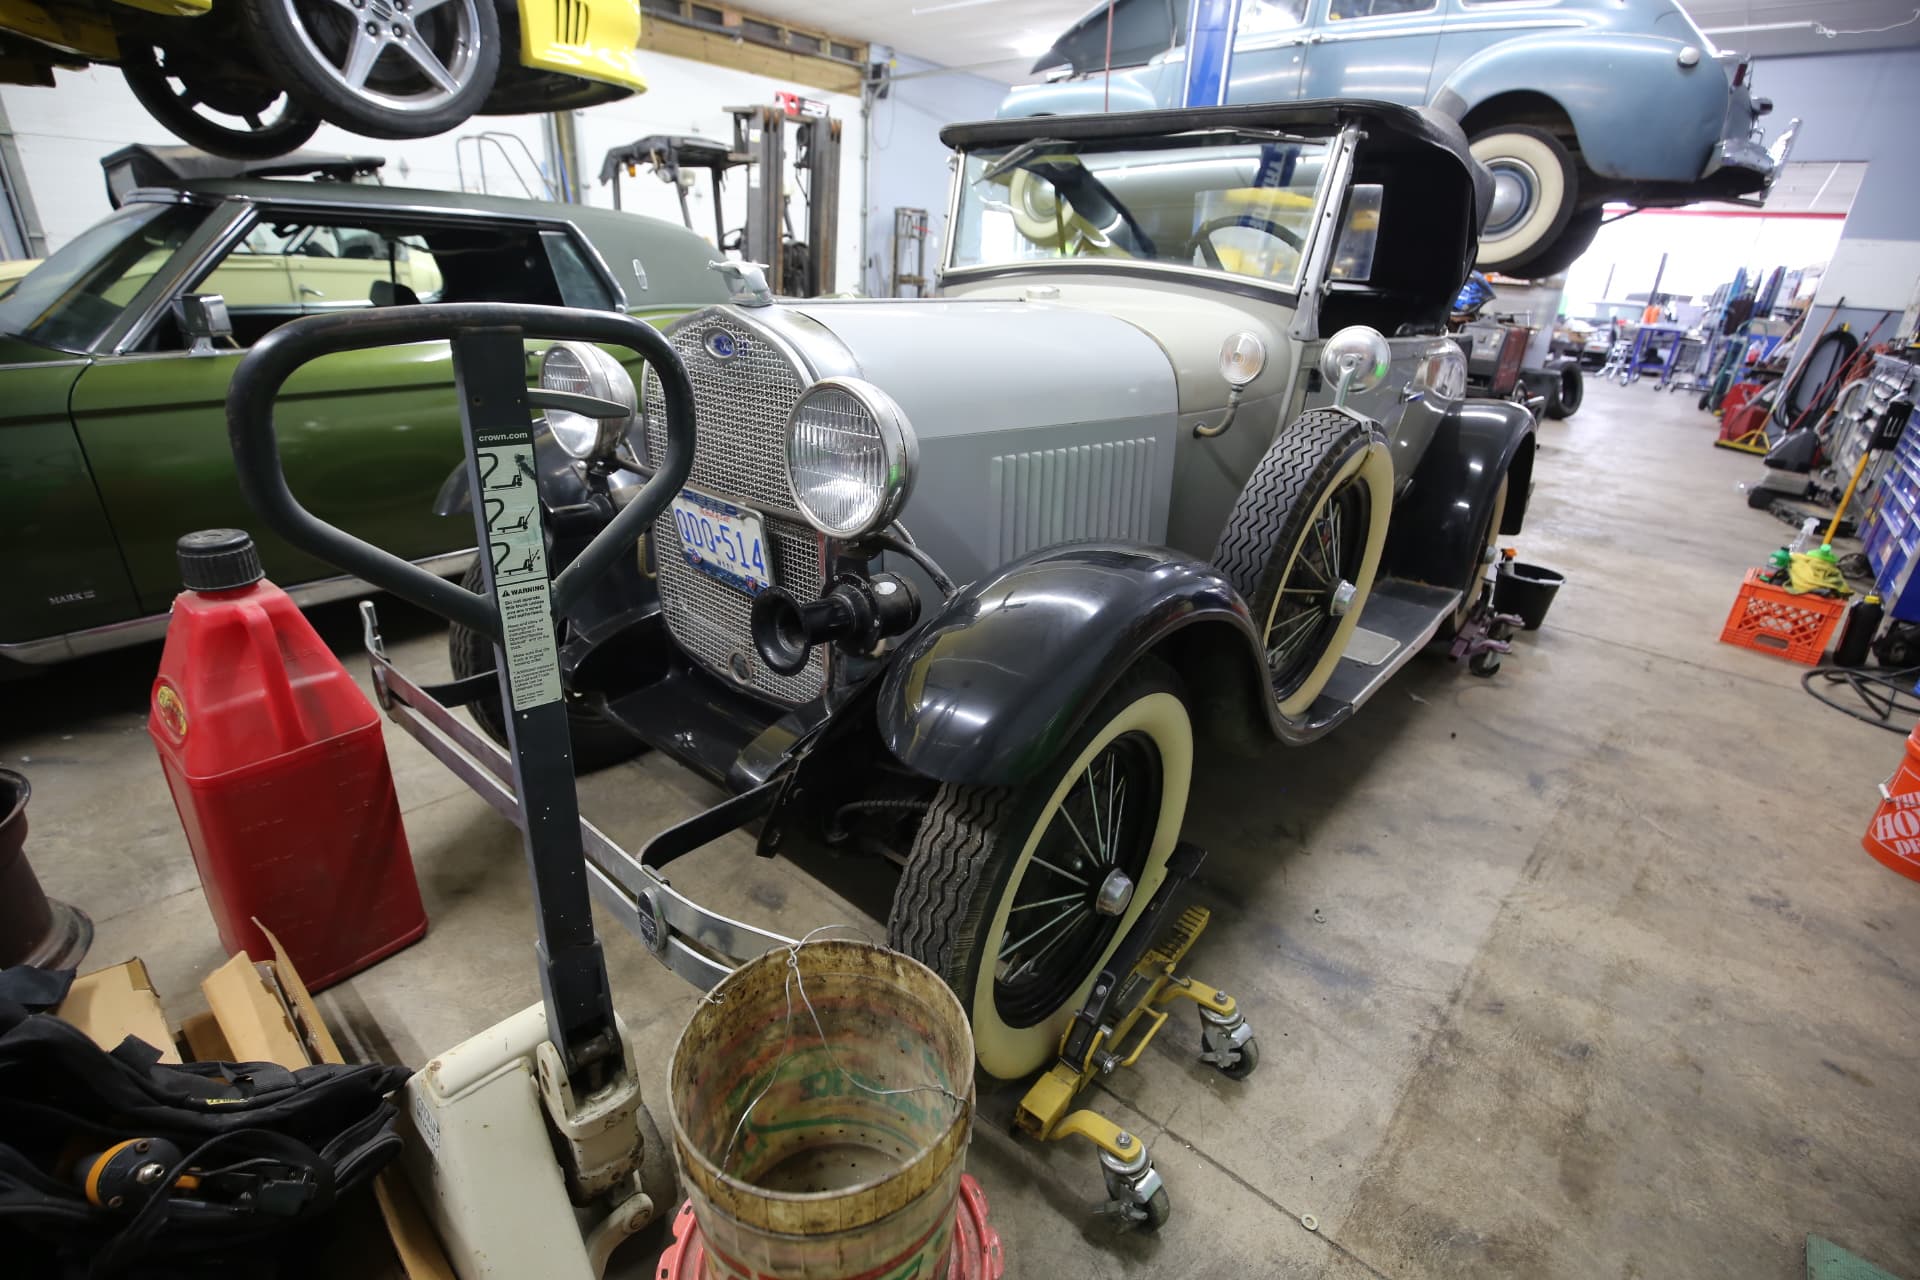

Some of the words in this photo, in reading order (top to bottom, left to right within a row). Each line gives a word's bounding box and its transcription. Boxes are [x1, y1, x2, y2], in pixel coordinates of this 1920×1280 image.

[478, 432, 528, 442] crown.com
[511, 585, 544, 595] WARNING
[1876, 808, 1920, 841] HO
